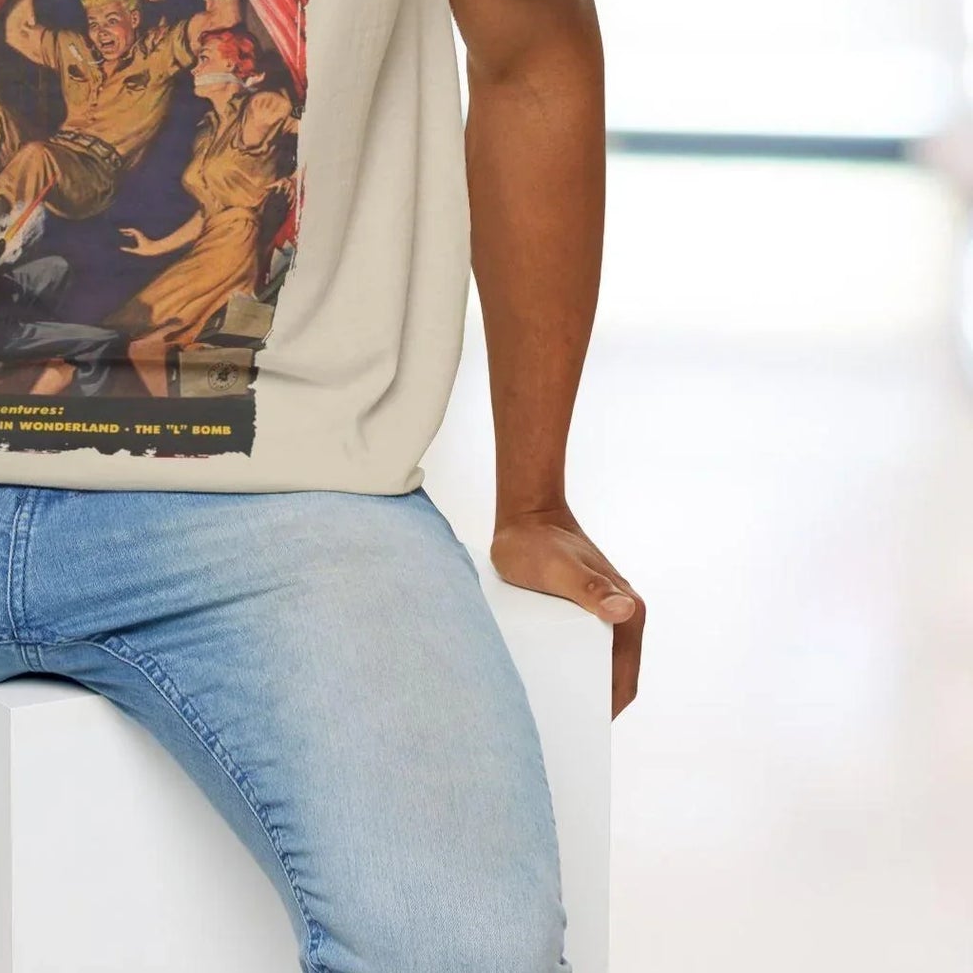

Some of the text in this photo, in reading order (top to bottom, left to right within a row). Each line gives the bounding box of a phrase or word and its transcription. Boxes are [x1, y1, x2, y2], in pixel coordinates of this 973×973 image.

[0, 420, 14, 431] IN
[19, 421, 120, 434] WONDERLAND
[135, 424, 161, 435] THE
[192, 425, 232, 436] BOMB
